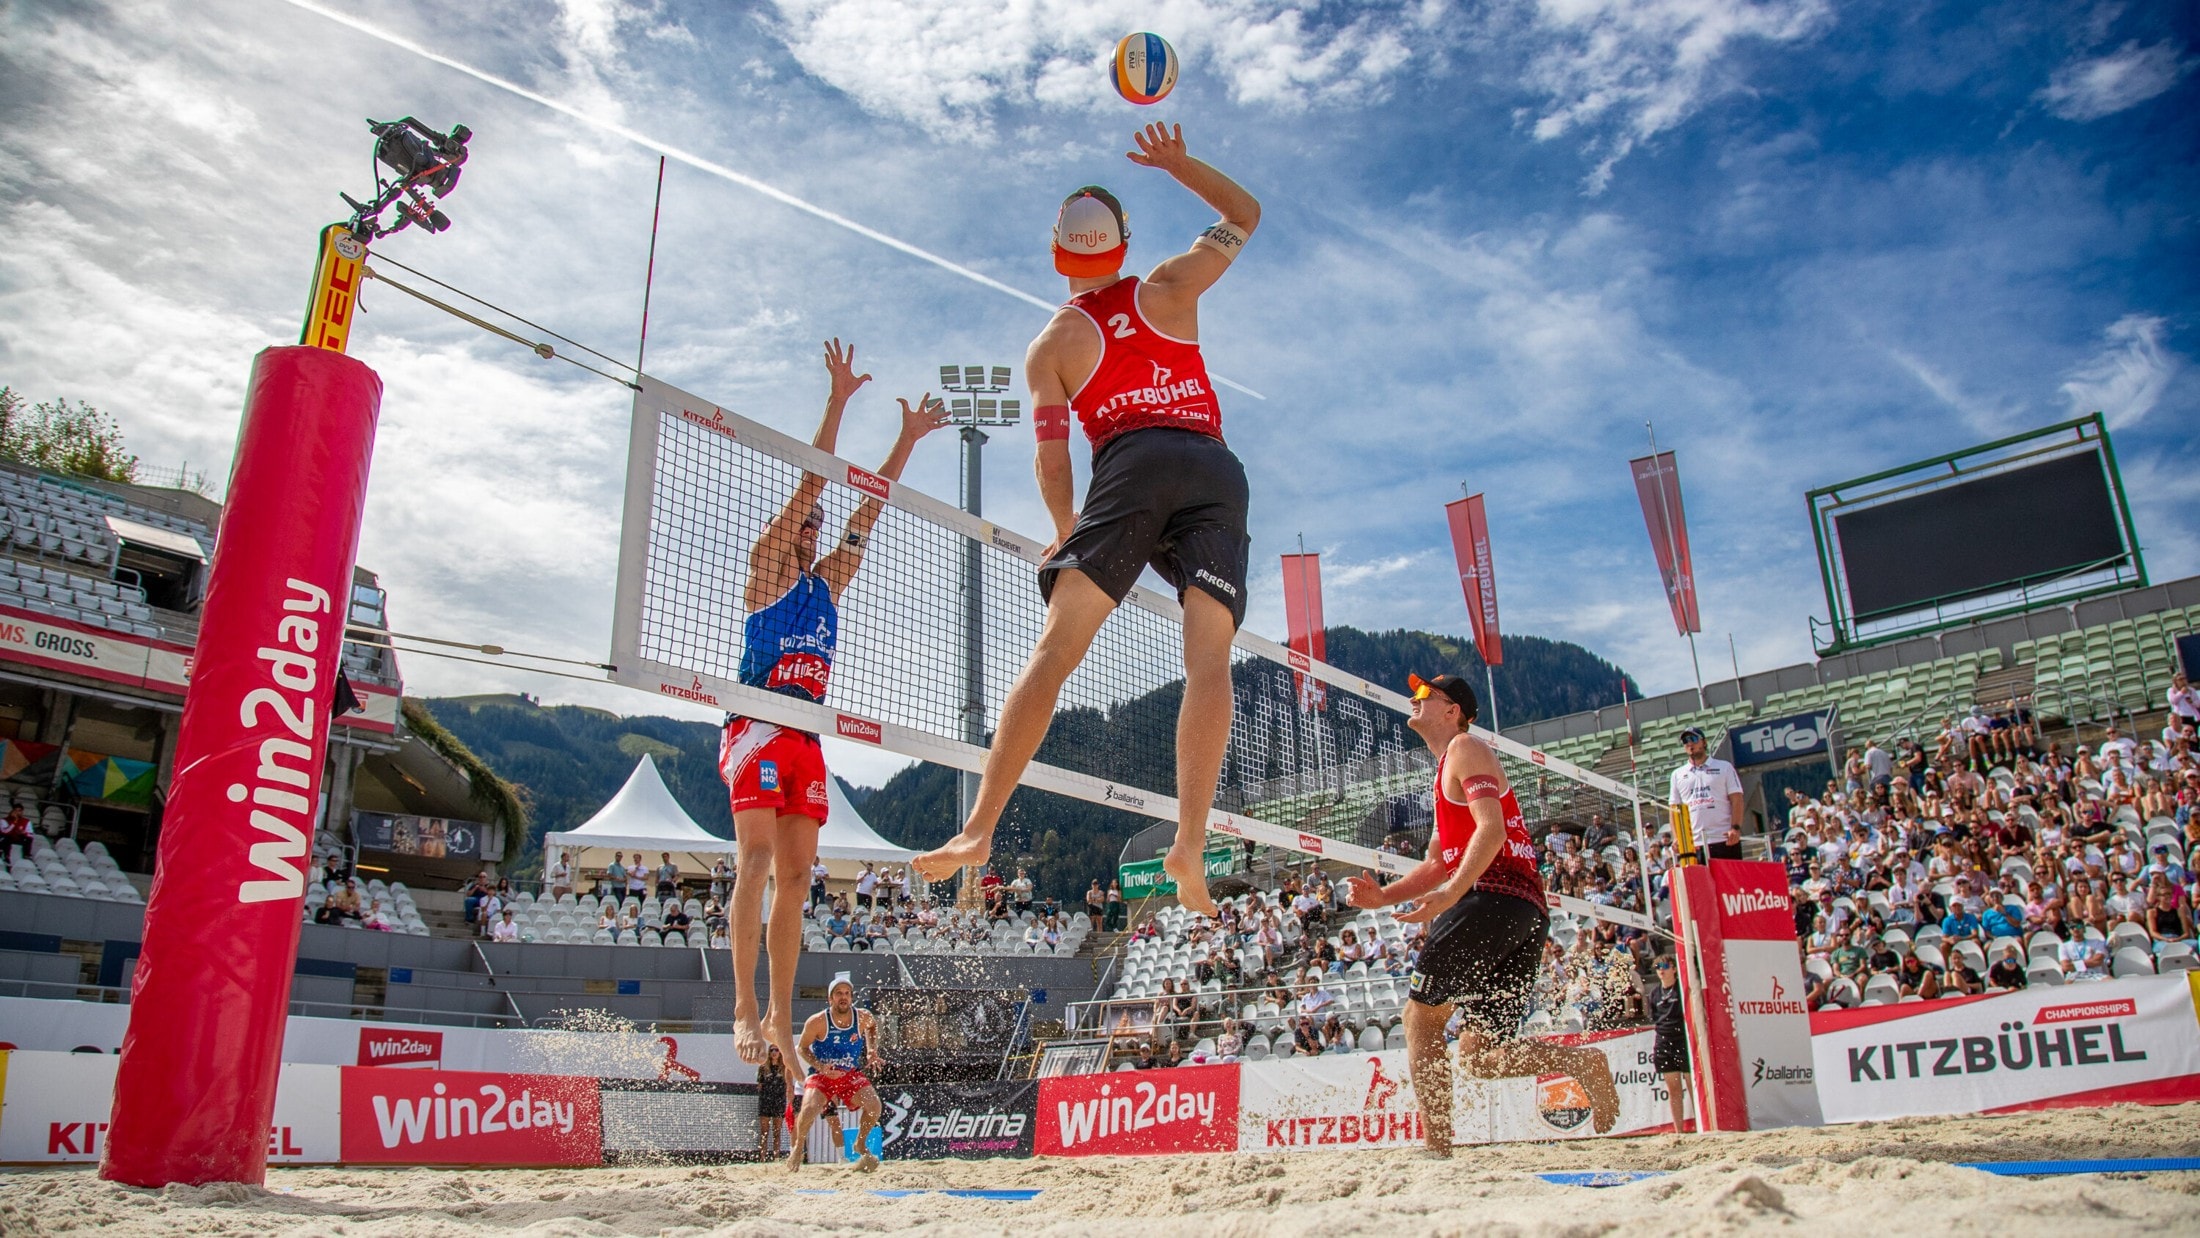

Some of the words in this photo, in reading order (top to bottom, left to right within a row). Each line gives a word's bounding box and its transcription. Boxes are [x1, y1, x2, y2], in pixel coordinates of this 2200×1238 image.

[1210, 233, 1233, 248] NOE
[1215, 228, 1243, 246] HYPO
[1107, 313, 1137, 339] 2
[849, 471, 888, 494] win2day
[1195, 569, 1237, 598] BERGER
[35, 631, 98, 660] GROSS.
[227, 578, 331, 903] win2day
[840, 720, 878, 738] win2day
[1740, 716, 1828, 753] Tirol
[1113, 791, 1145, 806] ballarina
[1122, 870, 1155, 888] Tiroler
[1722, 887, 1790, 917] win2day
[2045, 1002, 2130, 1020] CHAMPIONSHIPS
[369, 1037, 432, 1058] win2day
[1848, 1020, 2148, 1083] KITZBÜHEL
[1766, 1066, 1812, 1080] ballarina
[1651, 1087, 1687, 1102] Tor
[372, 1082, 574, 1149] win2day
[907, 1107, 1027, 1138] ballarina
[1058, 1081, 1216, 1149] win2day
[1266, 1111, 1430, 1147] KITZBÜH
